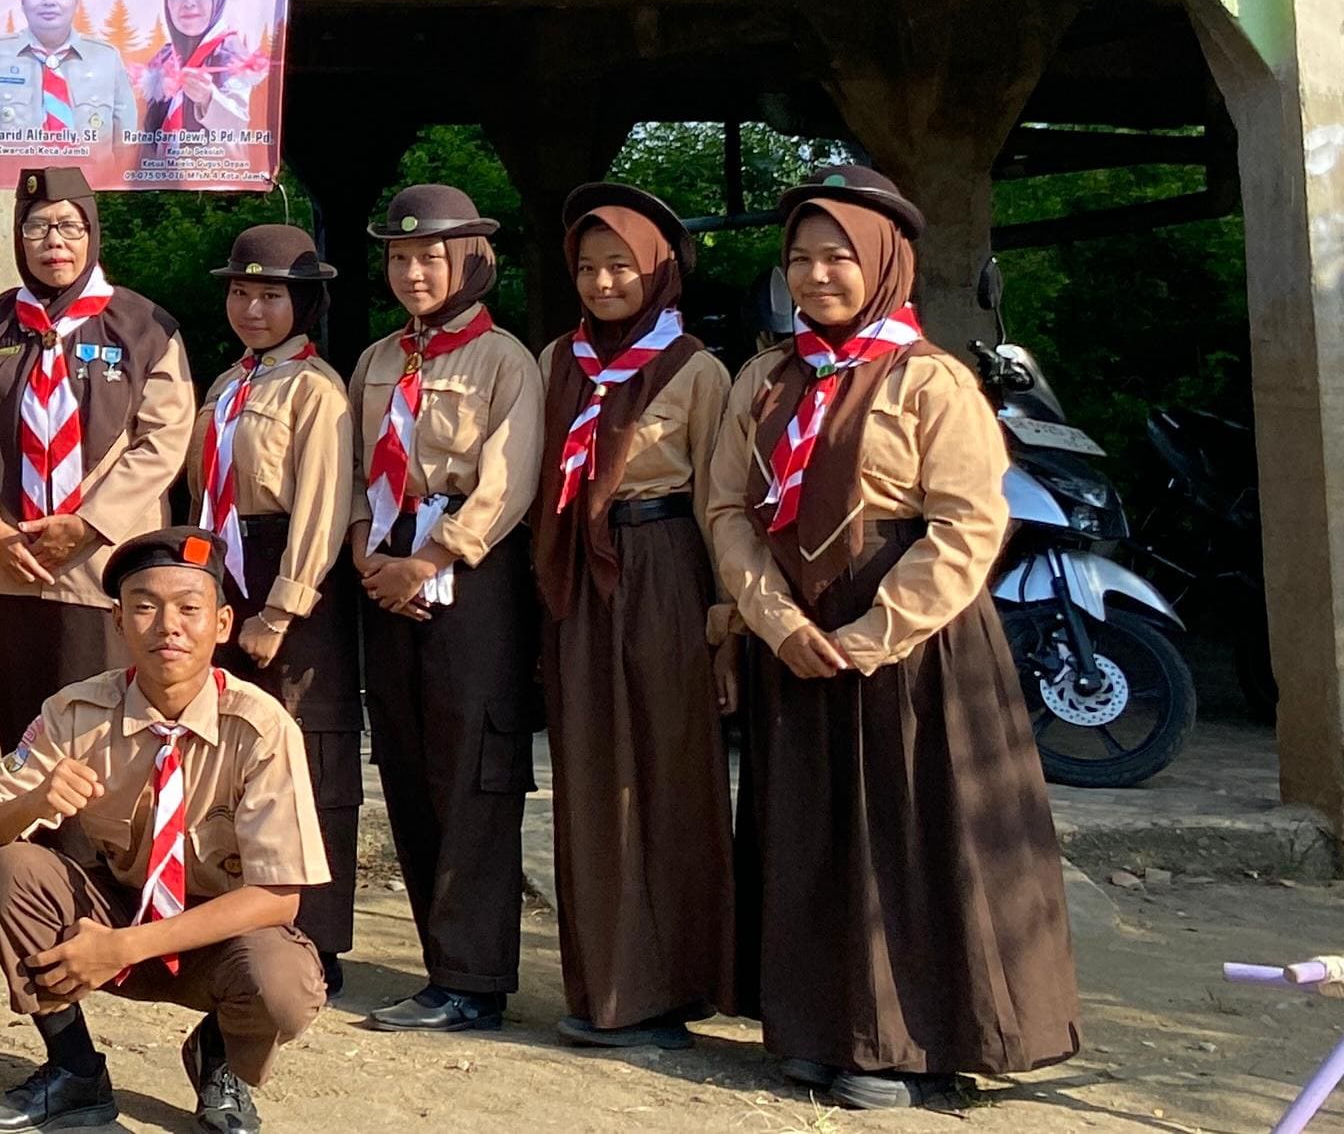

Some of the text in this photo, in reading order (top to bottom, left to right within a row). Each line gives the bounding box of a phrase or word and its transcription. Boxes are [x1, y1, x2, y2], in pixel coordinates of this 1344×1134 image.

[83, 129, 98, 141] SE
[155, 130, 177, 143] Sari
[38, 146, 59, 155] Kota
[62, 146, 90, 155] Jambi
[242, 172, 269, 181] Jamb
